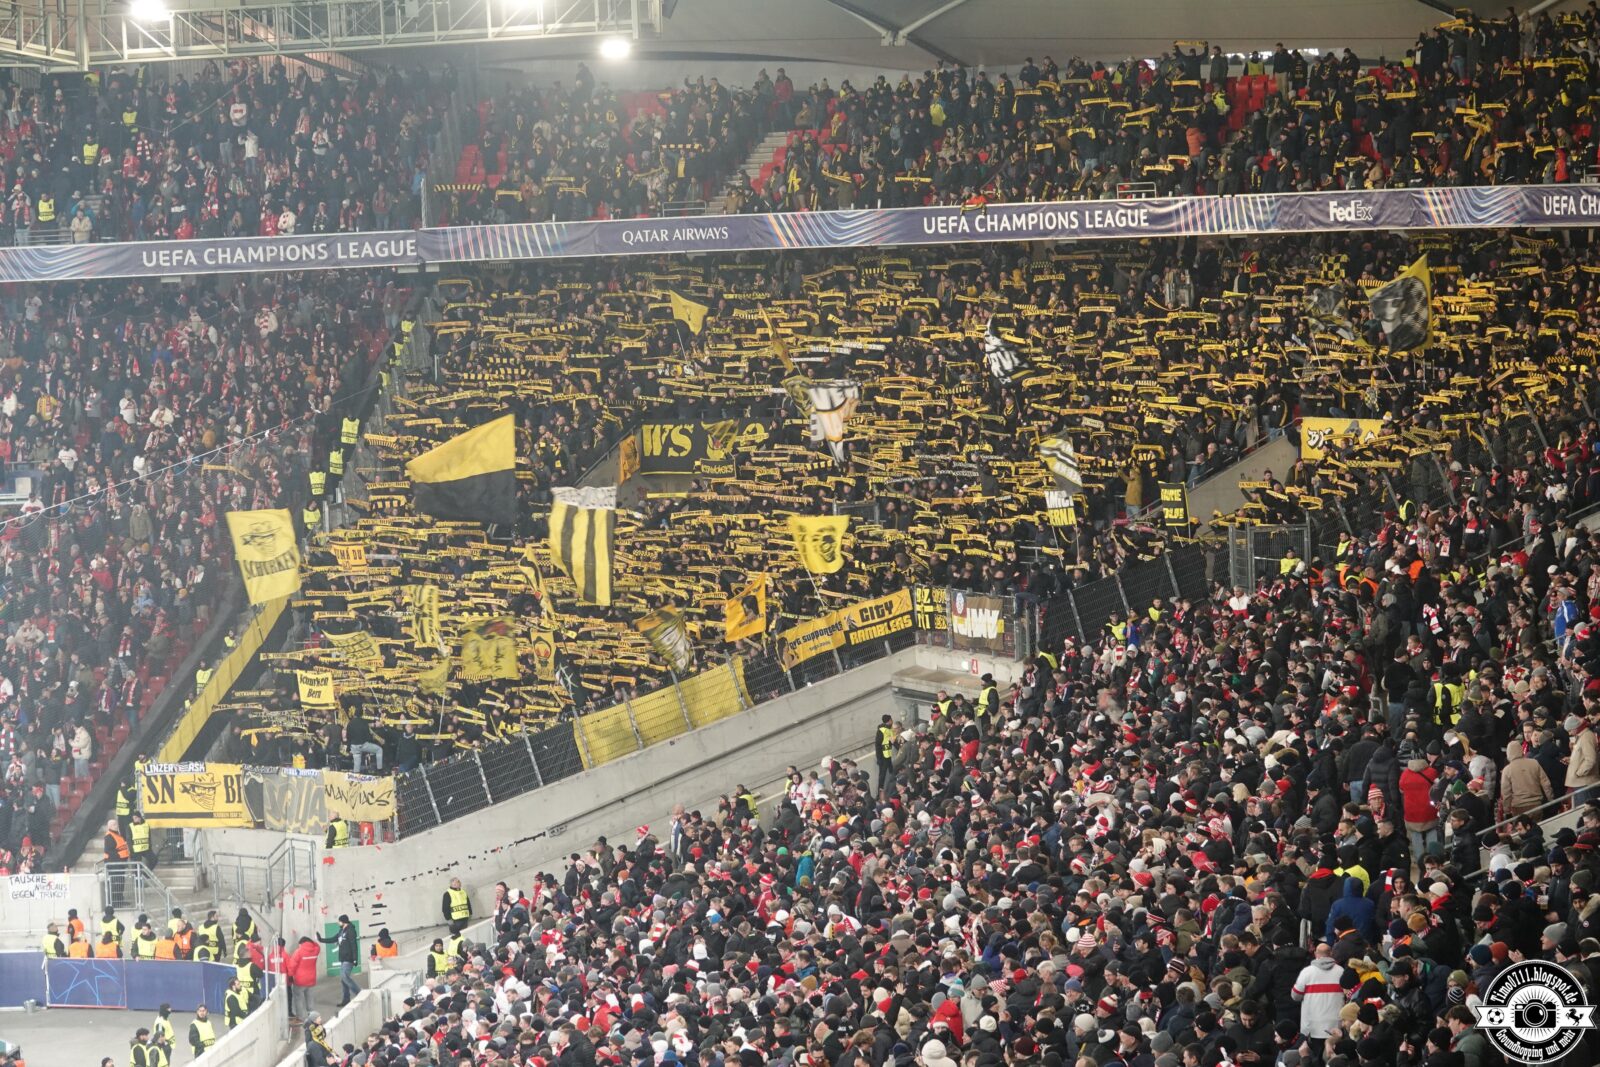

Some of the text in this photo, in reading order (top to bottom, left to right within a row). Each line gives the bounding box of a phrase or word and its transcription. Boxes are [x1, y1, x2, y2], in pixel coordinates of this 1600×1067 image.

[1329, 200, 1373, 221] FedEx
[1543, 195, 1577, 216] UEFA
[923, 208, 1149, 234] UEFA CHAMPIONS LEAGUE
[622, 226, 729, 246] QATAR AIRWAYS
[142, 239, 417, 267] UEFA CHAMPIONS LEAGUE
[859, 600, 894, 622] CITY
[849, 614, 913, 646] RAMBLERS
[144, 763, 174, 774] LINZER
[145, 774, 176, 804] SN
[9, 874, 47, 886] TAUSCHE
[12, 890, 35, 900] GEGEN
